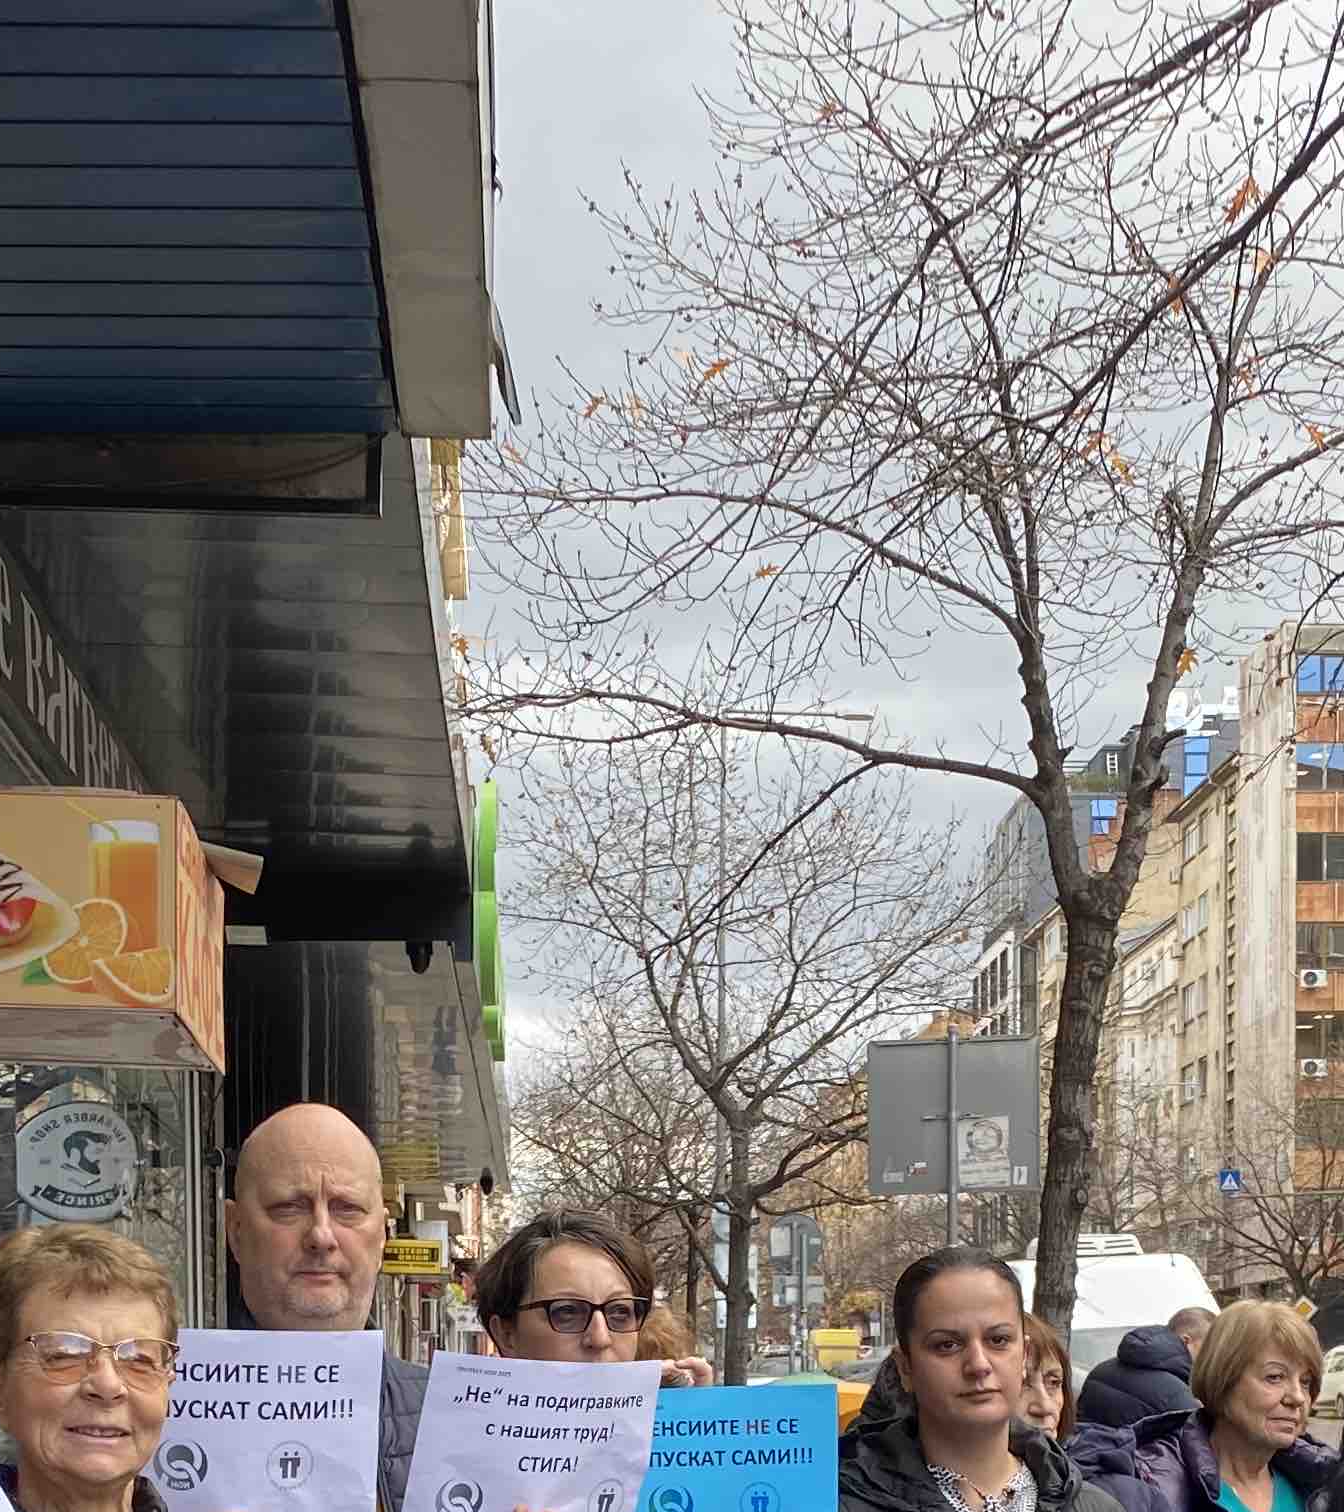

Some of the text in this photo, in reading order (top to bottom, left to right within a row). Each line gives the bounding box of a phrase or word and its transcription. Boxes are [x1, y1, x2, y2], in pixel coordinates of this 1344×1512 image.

[277, 1365, 306, 1384] НЕ
[314, 1364, 341, 1383] СЕ
[257, 1398, 353, 1421] САМИ!!!
[506, 1393, 530, 1407] на
[535, 1394, 643, 1413] подигравките
[485, 1422, 615, 1444] с нашият труд!
[745, 1418, 770, 1435] НЕ
[776, 1417, 799, 1434] СЕ
[518, 1455, 579, 1473] СТИГА!
[649, 1447, 813, 1468] ПУСКАТ САМИ!!!
